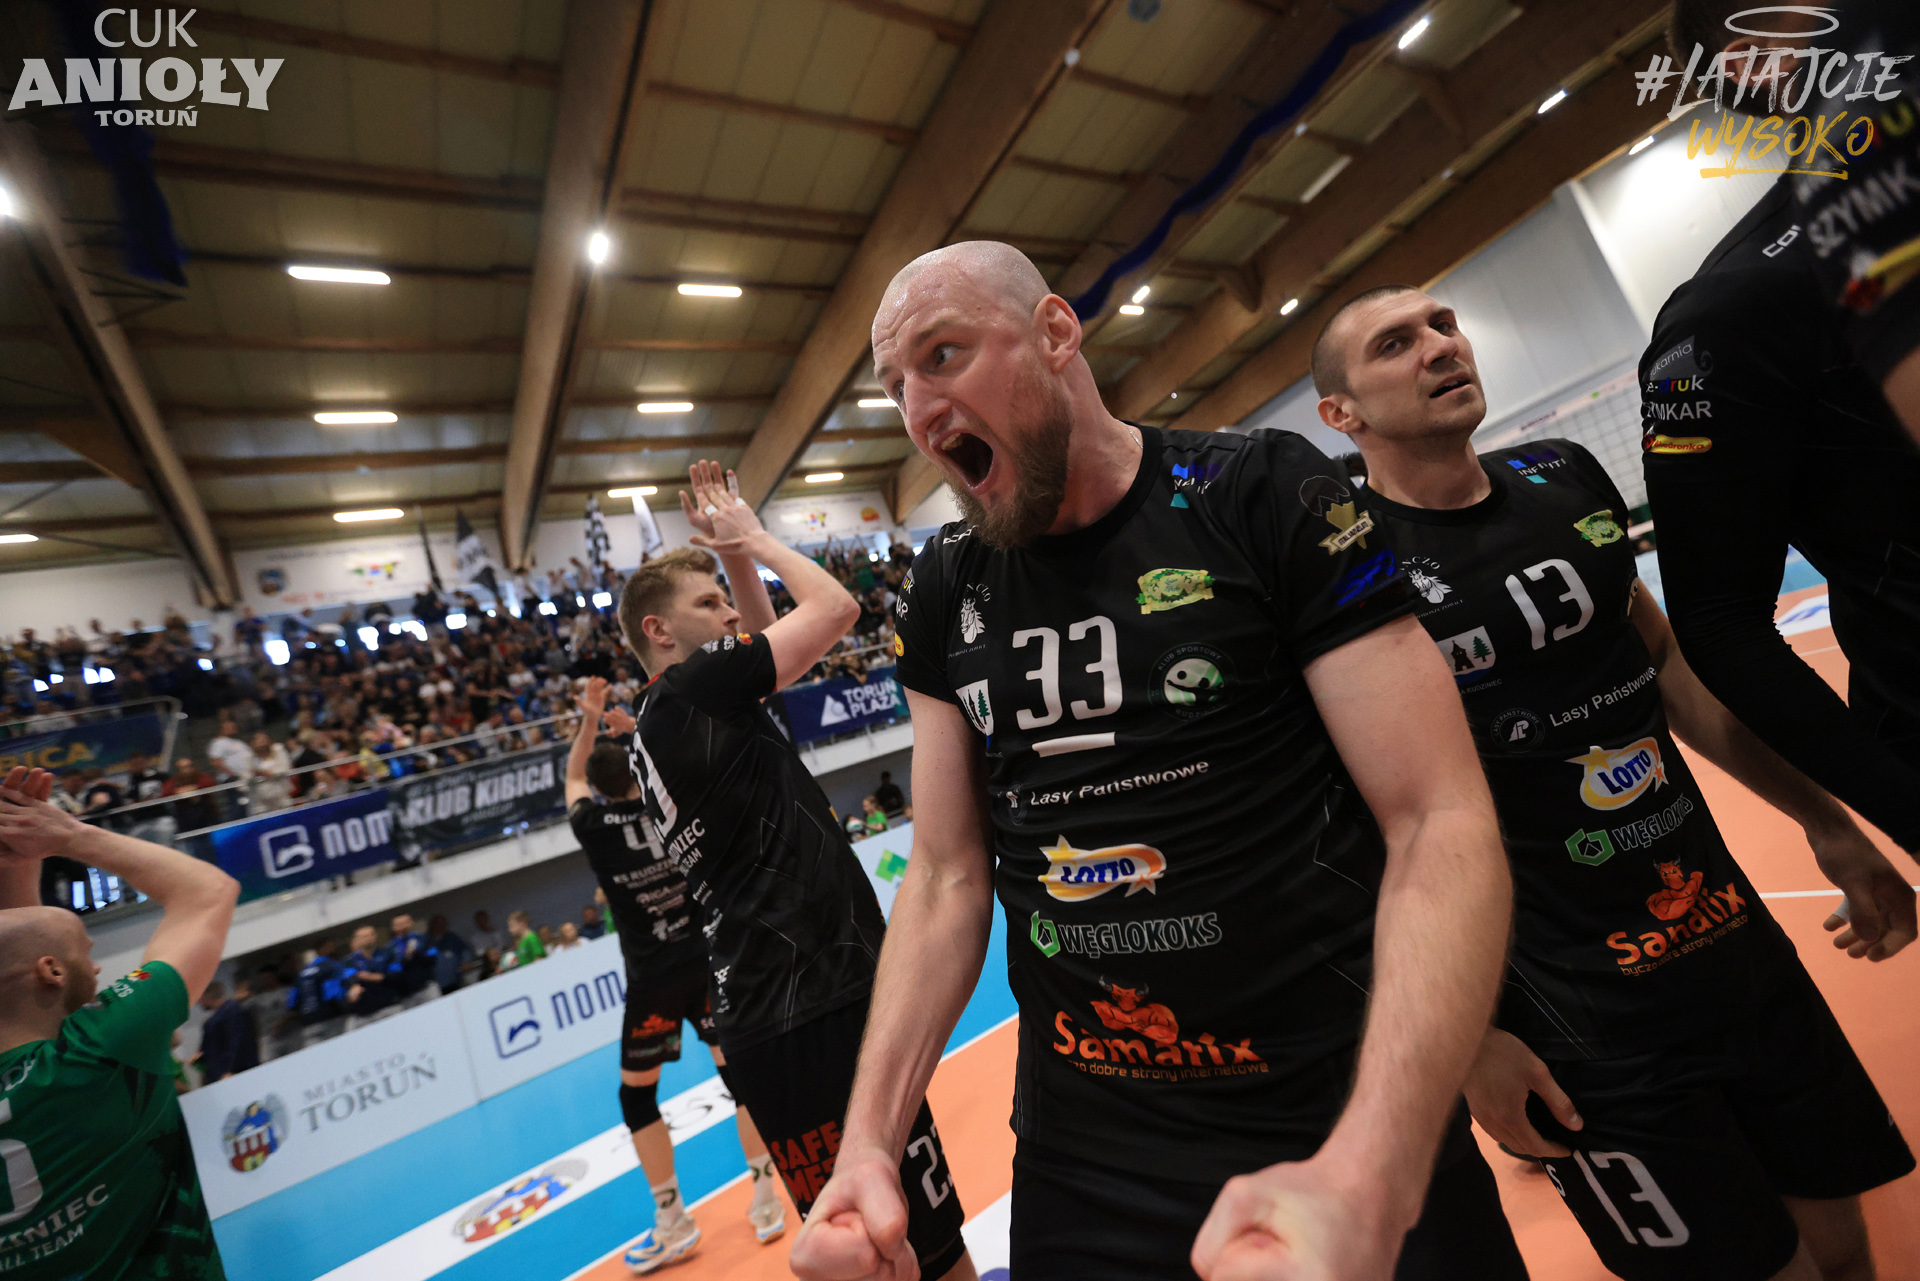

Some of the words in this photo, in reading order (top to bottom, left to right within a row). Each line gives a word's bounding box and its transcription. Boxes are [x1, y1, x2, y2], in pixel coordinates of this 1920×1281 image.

[1505, 559, 1594, 650] 13
[1012, 615, 1123, 731] 33
[1467, 679, 1503, 694] RUDZINIEC
[1550, 704, 1589, 727] Lasy
[1592, 666, 1656, 709] Państwowe
[850, 693, 902, 719] PLAZA
[474, 762, 556, 809] KIBICA
[1597, 750, 1652, 795] LOTTO
[1031, 788, 1073, 805] Lasy
[622, 815, 665, 860] 4
[1060, 858, 1135, 884] LOTTO
[1057, 911, 1223, 959] WĘGLOKOKS
[1680, 935, 1713, 955] strony
[298, 1052, 438, 1132] TORUŃ
[301, 1053, 406, 1100] MIASTO
[1089, 1062, 1127, 1077] dobre
[1131, 1066, 1178, 1082] strony
[1180, 1062, 1270, 1080] internetowe
[771, 1119, 843, 1172] SAFE
[907, 1124, 953, 1210] 2
[1573, 1150, 1690, 1247] 13
